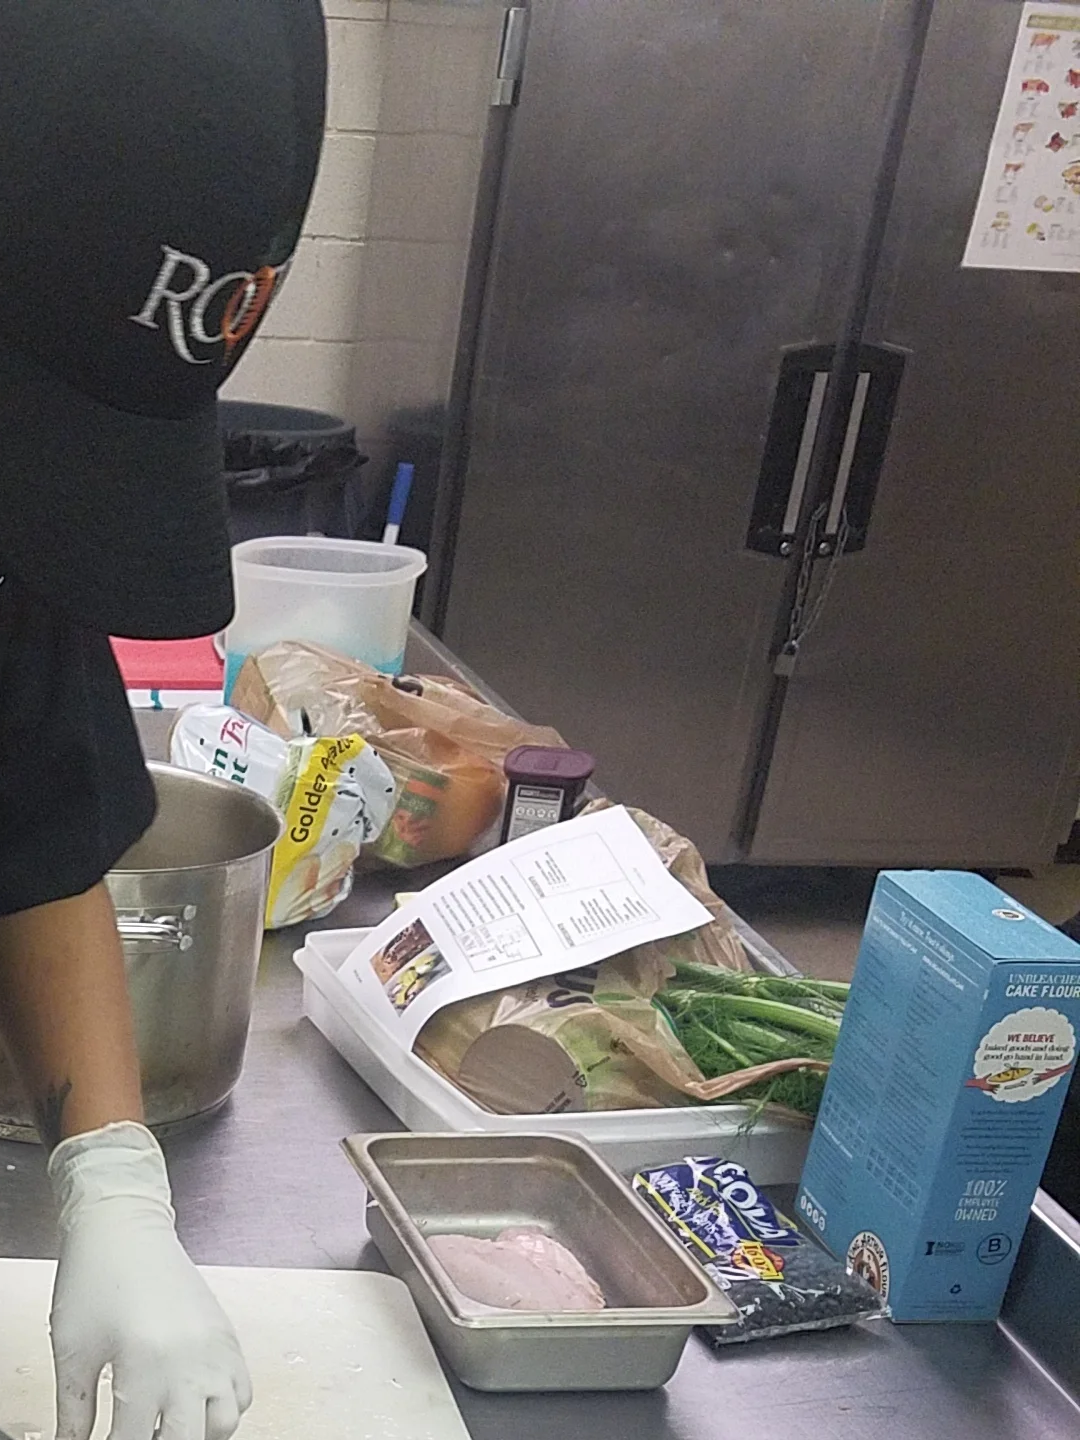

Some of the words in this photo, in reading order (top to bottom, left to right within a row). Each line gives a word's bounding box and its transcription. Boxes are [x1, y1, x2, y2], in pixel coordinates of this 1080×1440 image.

[1005, 984, 1039, 998] CAKE
[1040, 985, 1080, 998] FLOUR
[1007, 1033, 1022, 1042] WE
[1022, 1033, 1055, 1043] BELIEVE
[962, 1180, 1008, 1197] 100%
[955, 1208, 997, 1221] OWNED
[988, 1238, 1001, 1253] B
